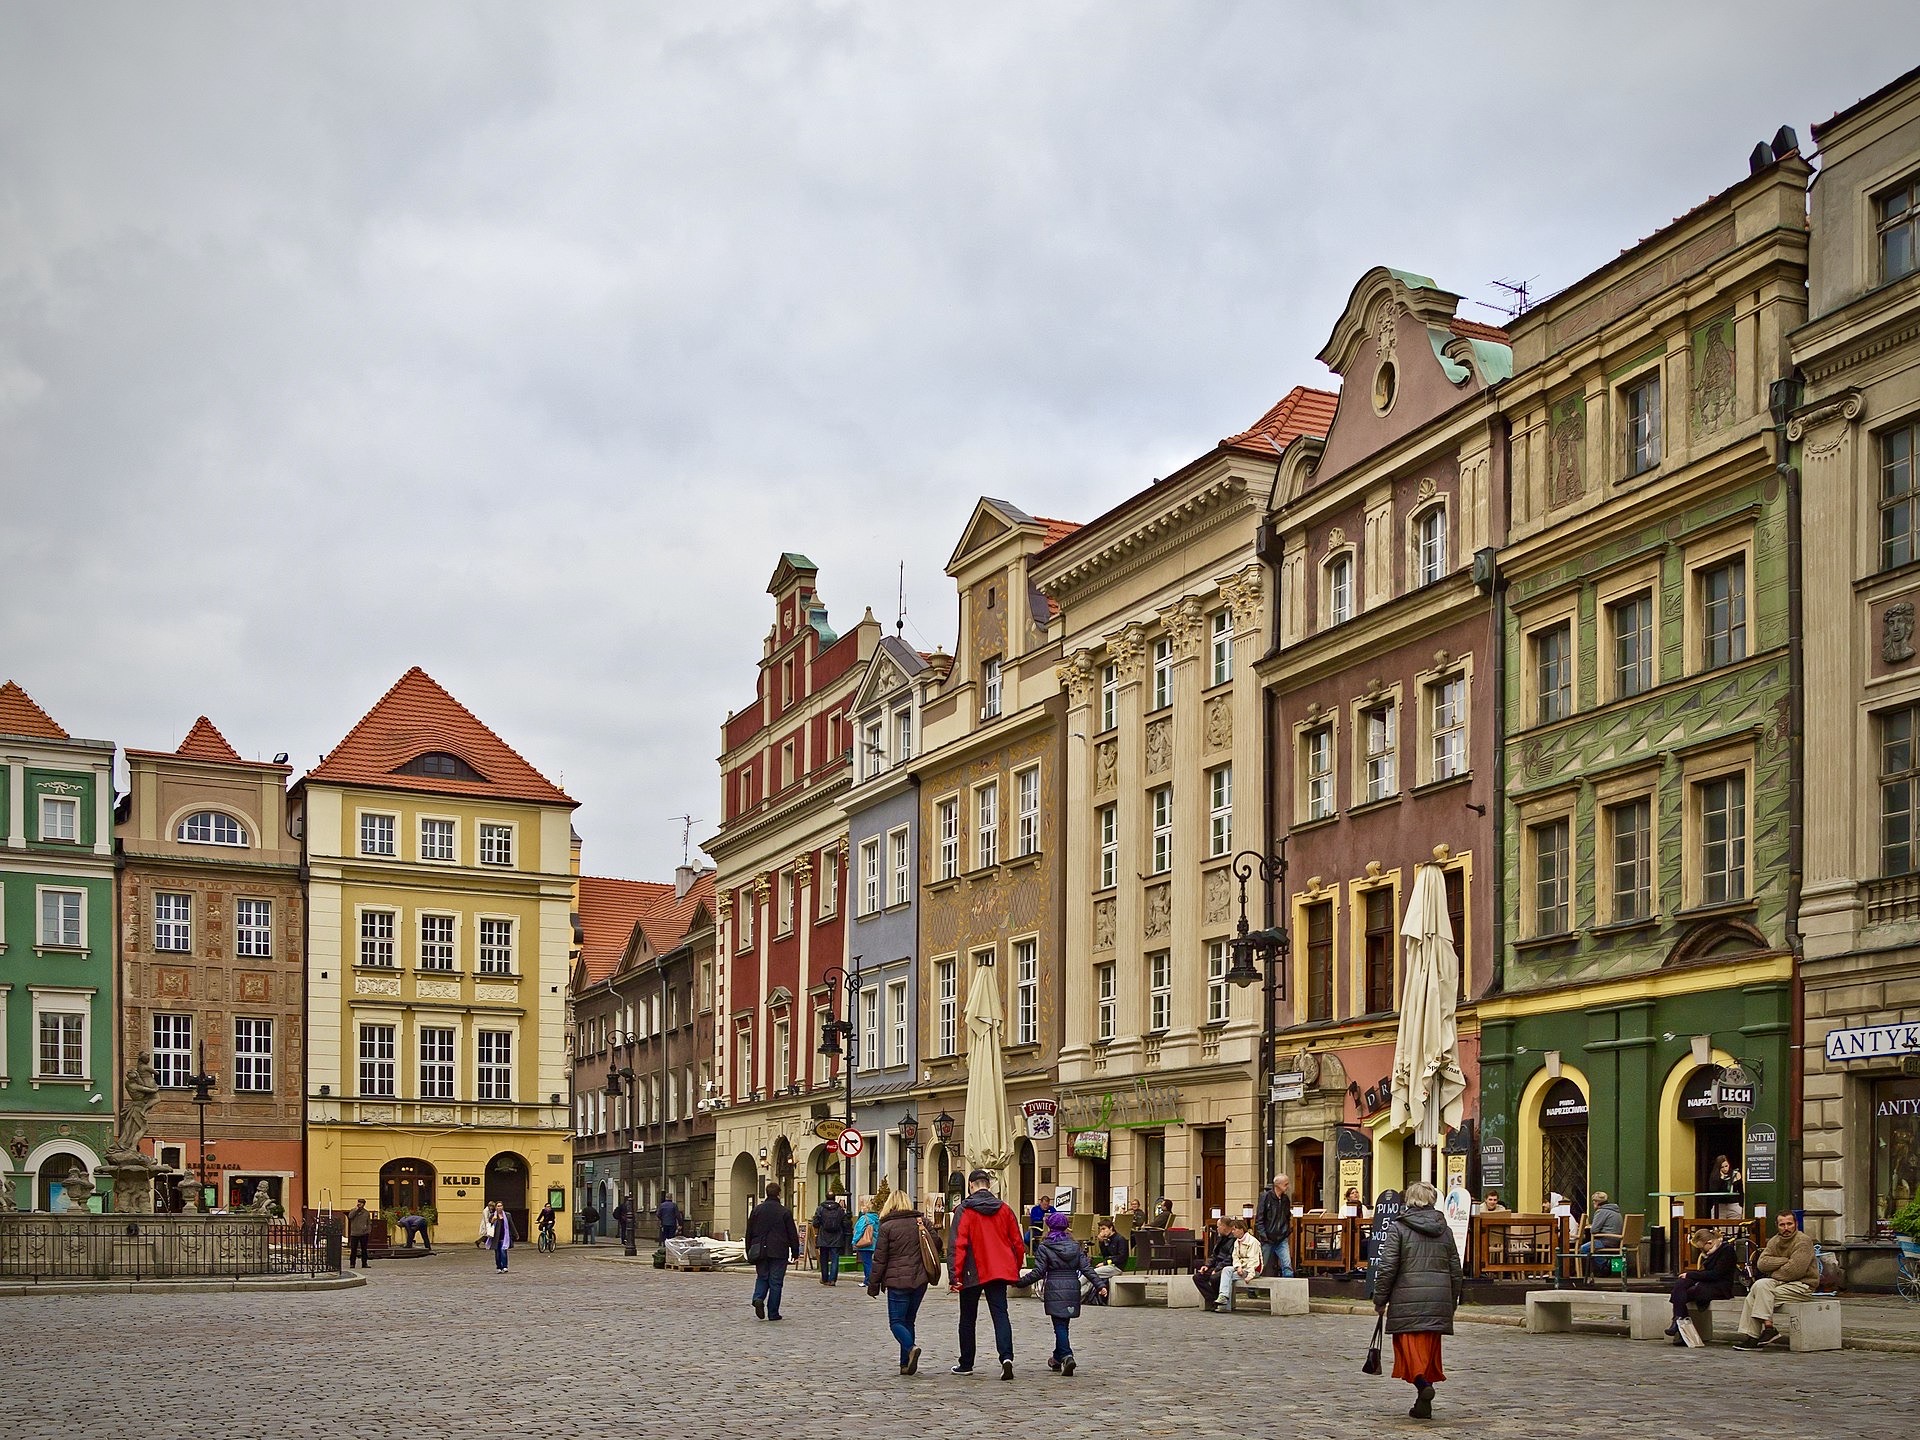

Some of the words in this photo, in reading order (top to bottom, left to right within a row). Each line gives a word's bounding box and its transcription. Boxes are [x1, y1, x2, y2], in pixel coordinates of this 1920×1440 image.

[1831, 1027, 1918, 1056] ANTYK
[1721, 1088, 1751, 1102] LECH
[1727, 1107, 1747, 1116] PILS
[1747, 1132, 1775, 1142] ANTYKI
[1482, 1145, 1504, 1154] ANTYKI
[442, 1176, 481, 1186] KLUB
[1377, 1203, 1399, 1214] PIWO
